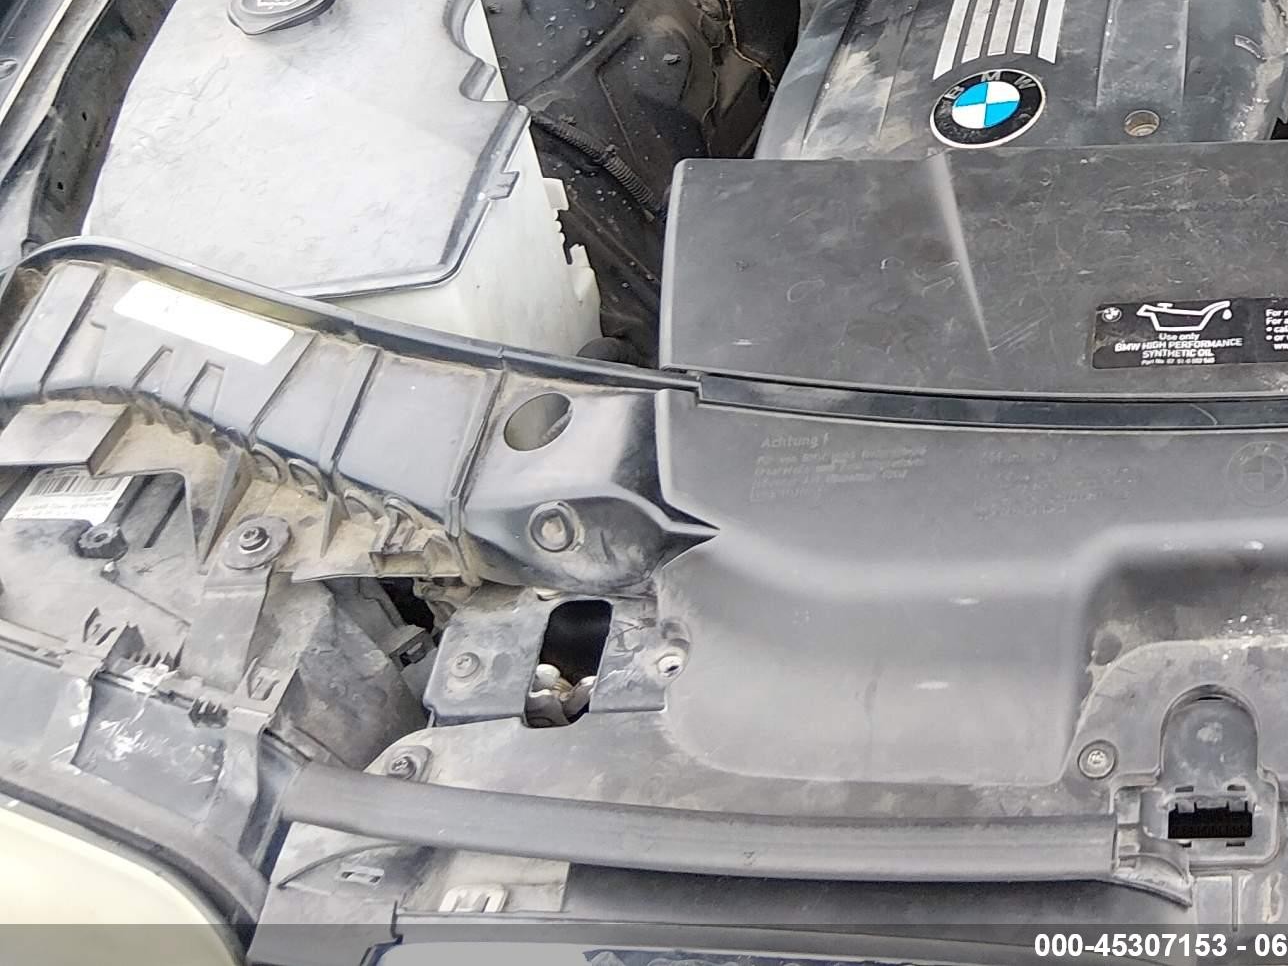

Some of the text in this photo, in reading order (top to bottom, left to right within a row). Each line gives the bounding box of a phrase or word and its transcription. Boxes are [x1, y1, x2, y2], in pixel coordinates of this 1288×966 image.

[1266, 309, 1282, 317] For
[1266, 317, 1282, 325] For
[1179, 333, 1200, 341] only
[1114, 338, 1242, 352] BMW HIGH PERFORMANCE
[1142, 348, 1215, 359] SYNTHETIC OIL
[760, 435, 819, 448] Achtung
